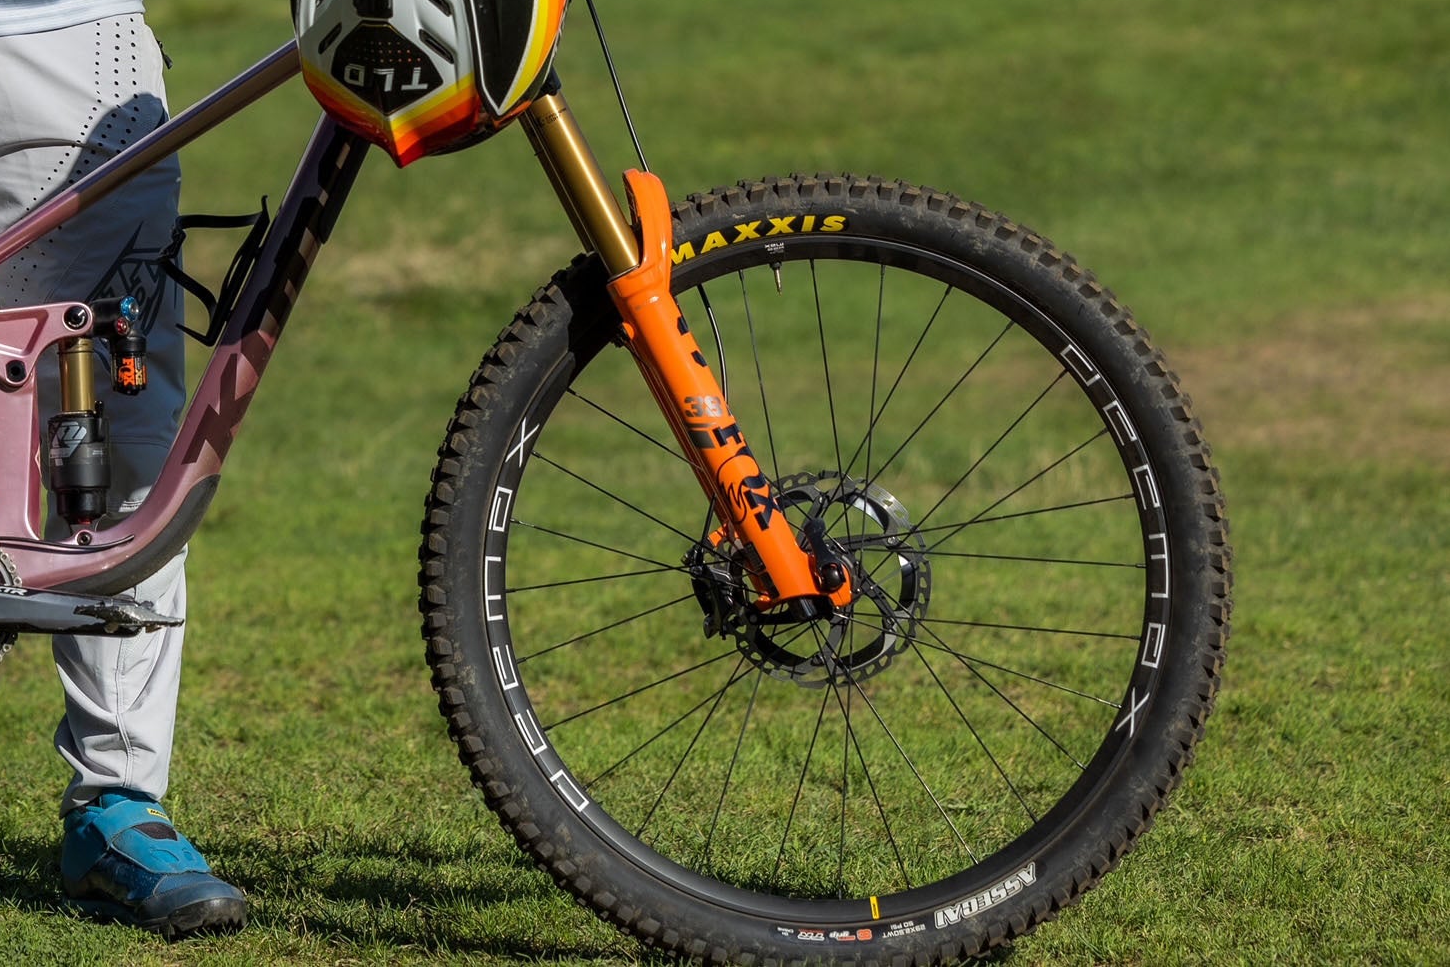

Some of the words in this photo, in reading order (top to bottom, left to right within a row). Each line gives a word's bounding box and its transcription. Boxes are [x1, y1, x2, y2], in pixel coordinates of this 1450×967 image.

[343, 63, 429, 92] TLD
[671, 214, 848, 265] MAXXIS
[683, 395, 723, 418] 38
[933, 862, 1037, 929] ASSEGAI
